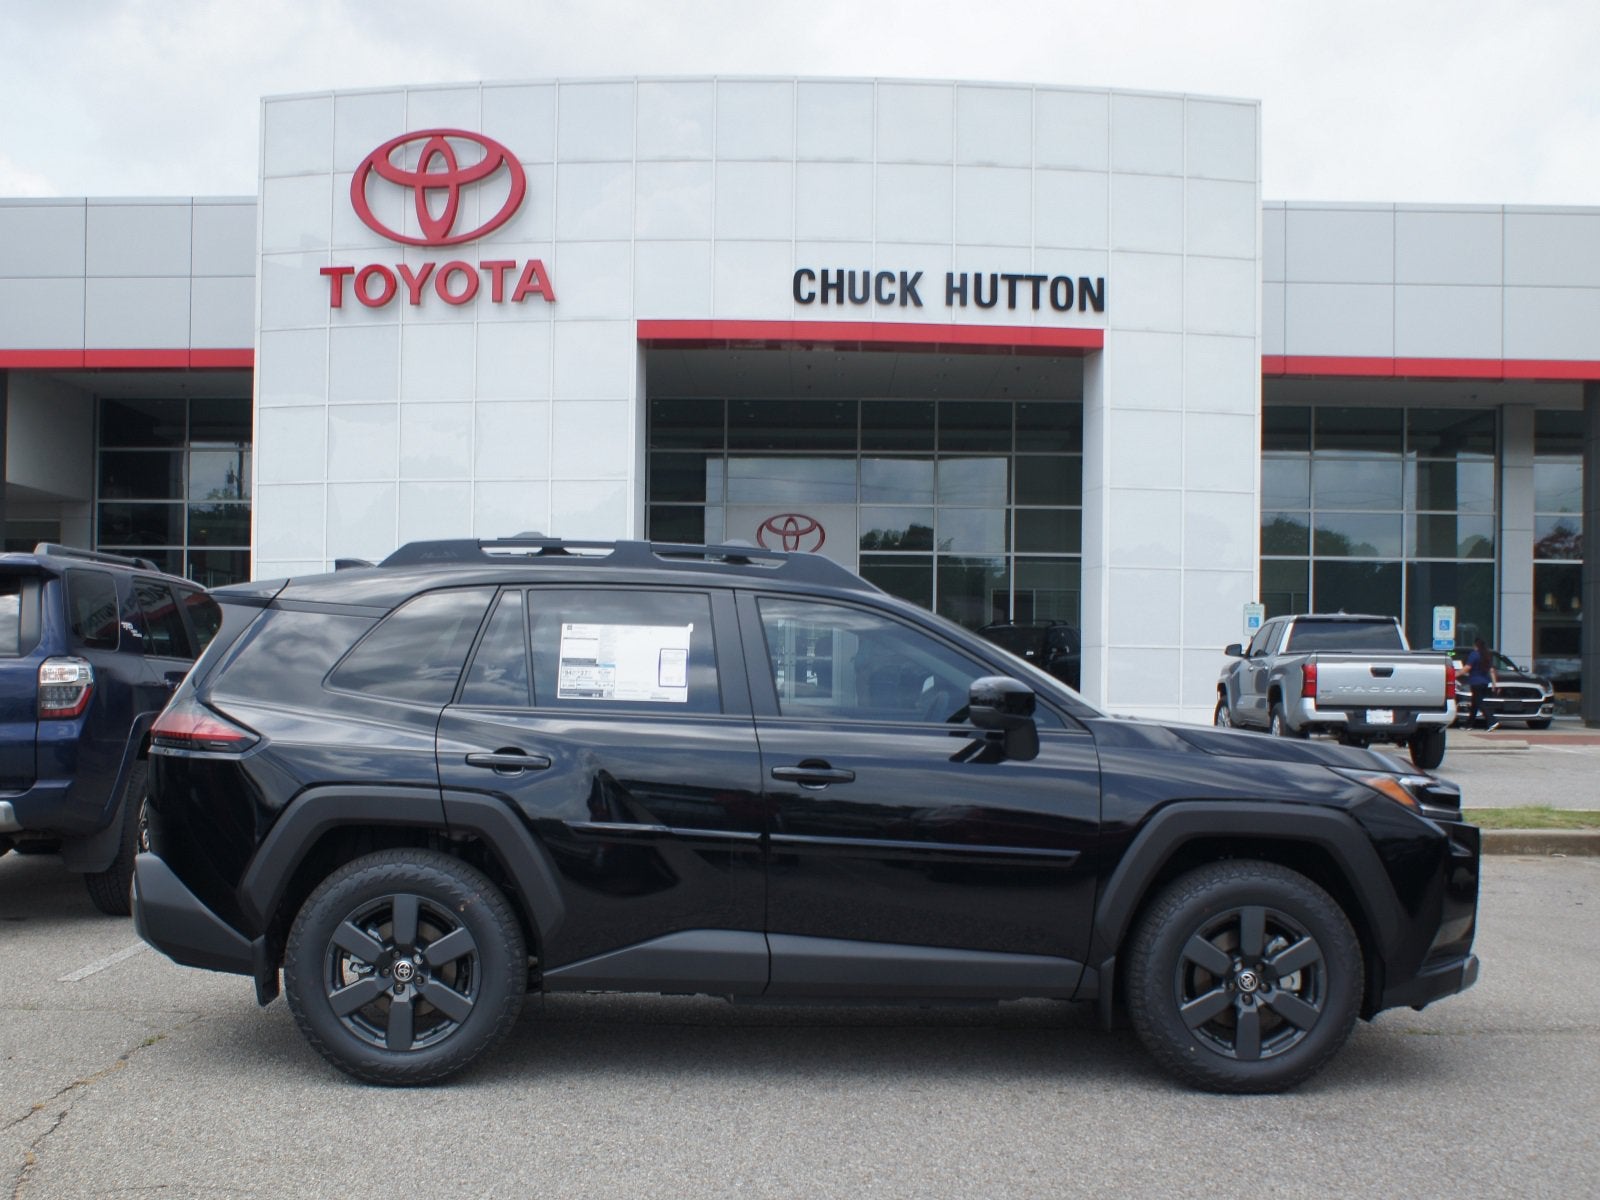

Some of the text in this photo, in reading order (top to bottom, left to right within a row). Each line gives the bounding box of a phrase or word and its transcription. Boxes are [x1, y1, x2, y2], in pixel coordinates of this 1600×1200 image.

[319, 259, 556, 308] TOYOTA
[793, 268, 1105, 312] CHUCK HUTTON
[1338, 685, 1427, 694] TACOMA
